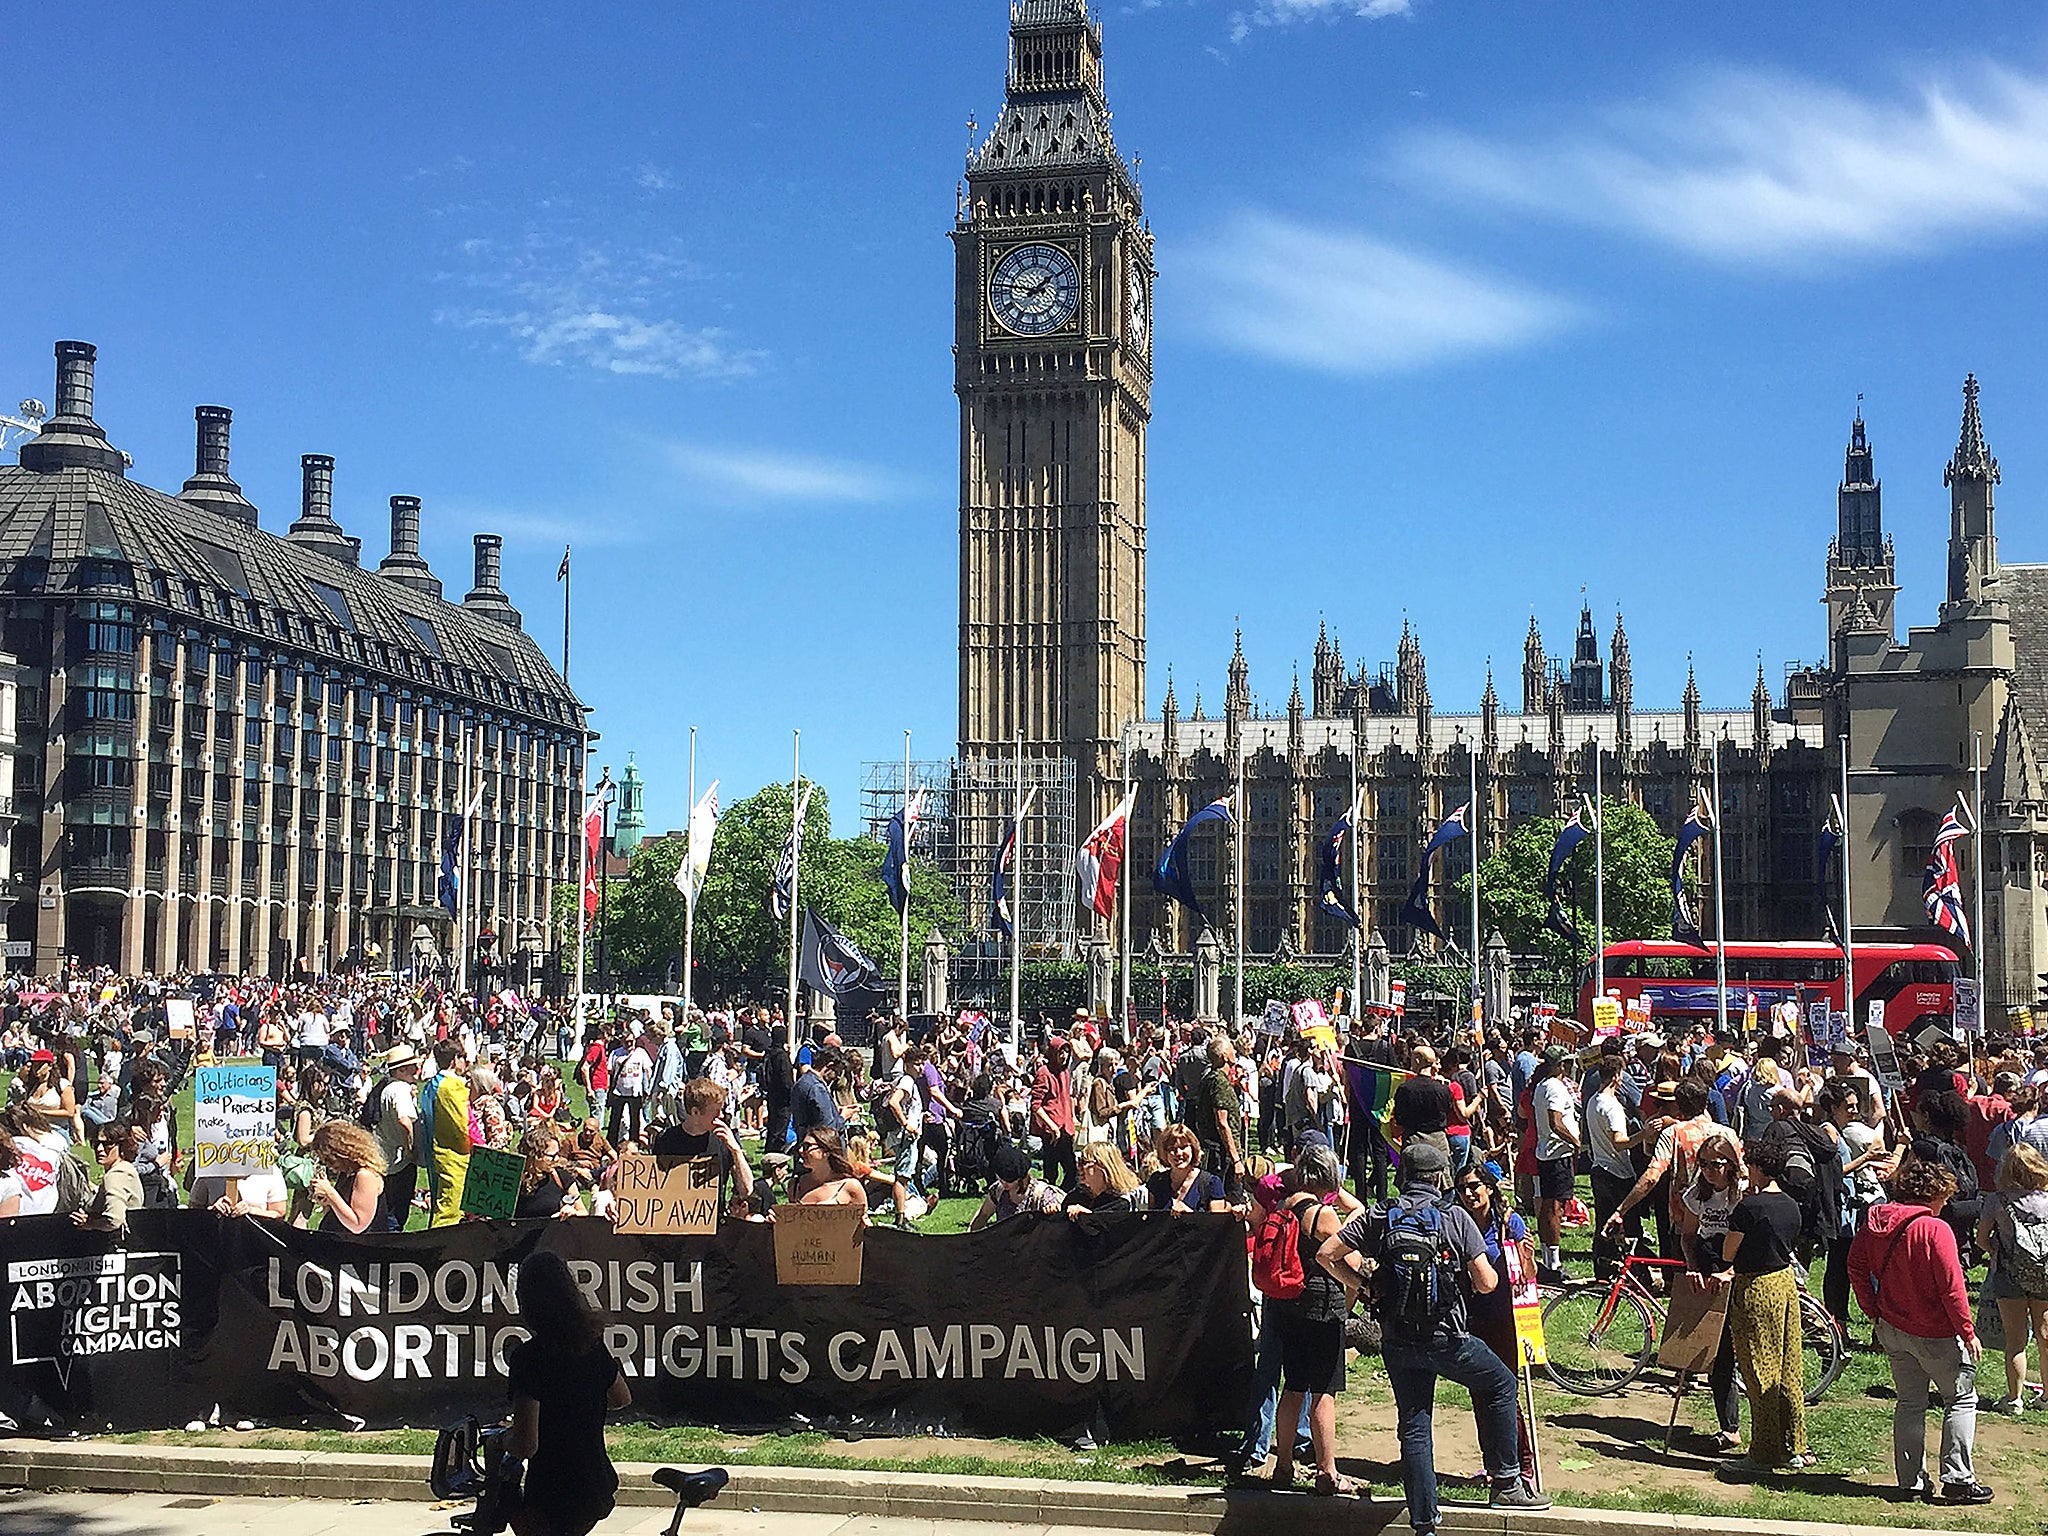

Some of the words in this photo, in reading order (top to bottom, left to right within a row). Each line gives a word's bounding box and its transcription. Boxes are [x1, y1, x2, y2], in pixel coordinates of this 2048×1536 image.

[200, 1071, 272, 1094] Politicians
[203, 1094, 219, 1104] and
[198, 1117, 225, 1128] make
[224, 1121, 275, 1139] terrible
[197, 1138, 279, 1169] DOCTORS
[469, 1166, 515, 1192] SAFE
[621, 1160, 674, 1190] PRAY
[465, 1187, 513, 1217] LEGAL
[617, 1198, 664, 1229] DUP
[667, 1199, 717, 1227] AWAY
[10, 1272, 181, 1312] ABORTION
[268, 1257, 521, 1316] LONDON
[567, 1260, 704, 1313] RISH
[61, 1301, 181, 1336] RIGHTS
[60, 1330, 181, 1357] CAMPAIGN
[603, 1323, 810, 1384] RIGHTS
[828, 1324, 1146, 1383] CAMPAIGN
